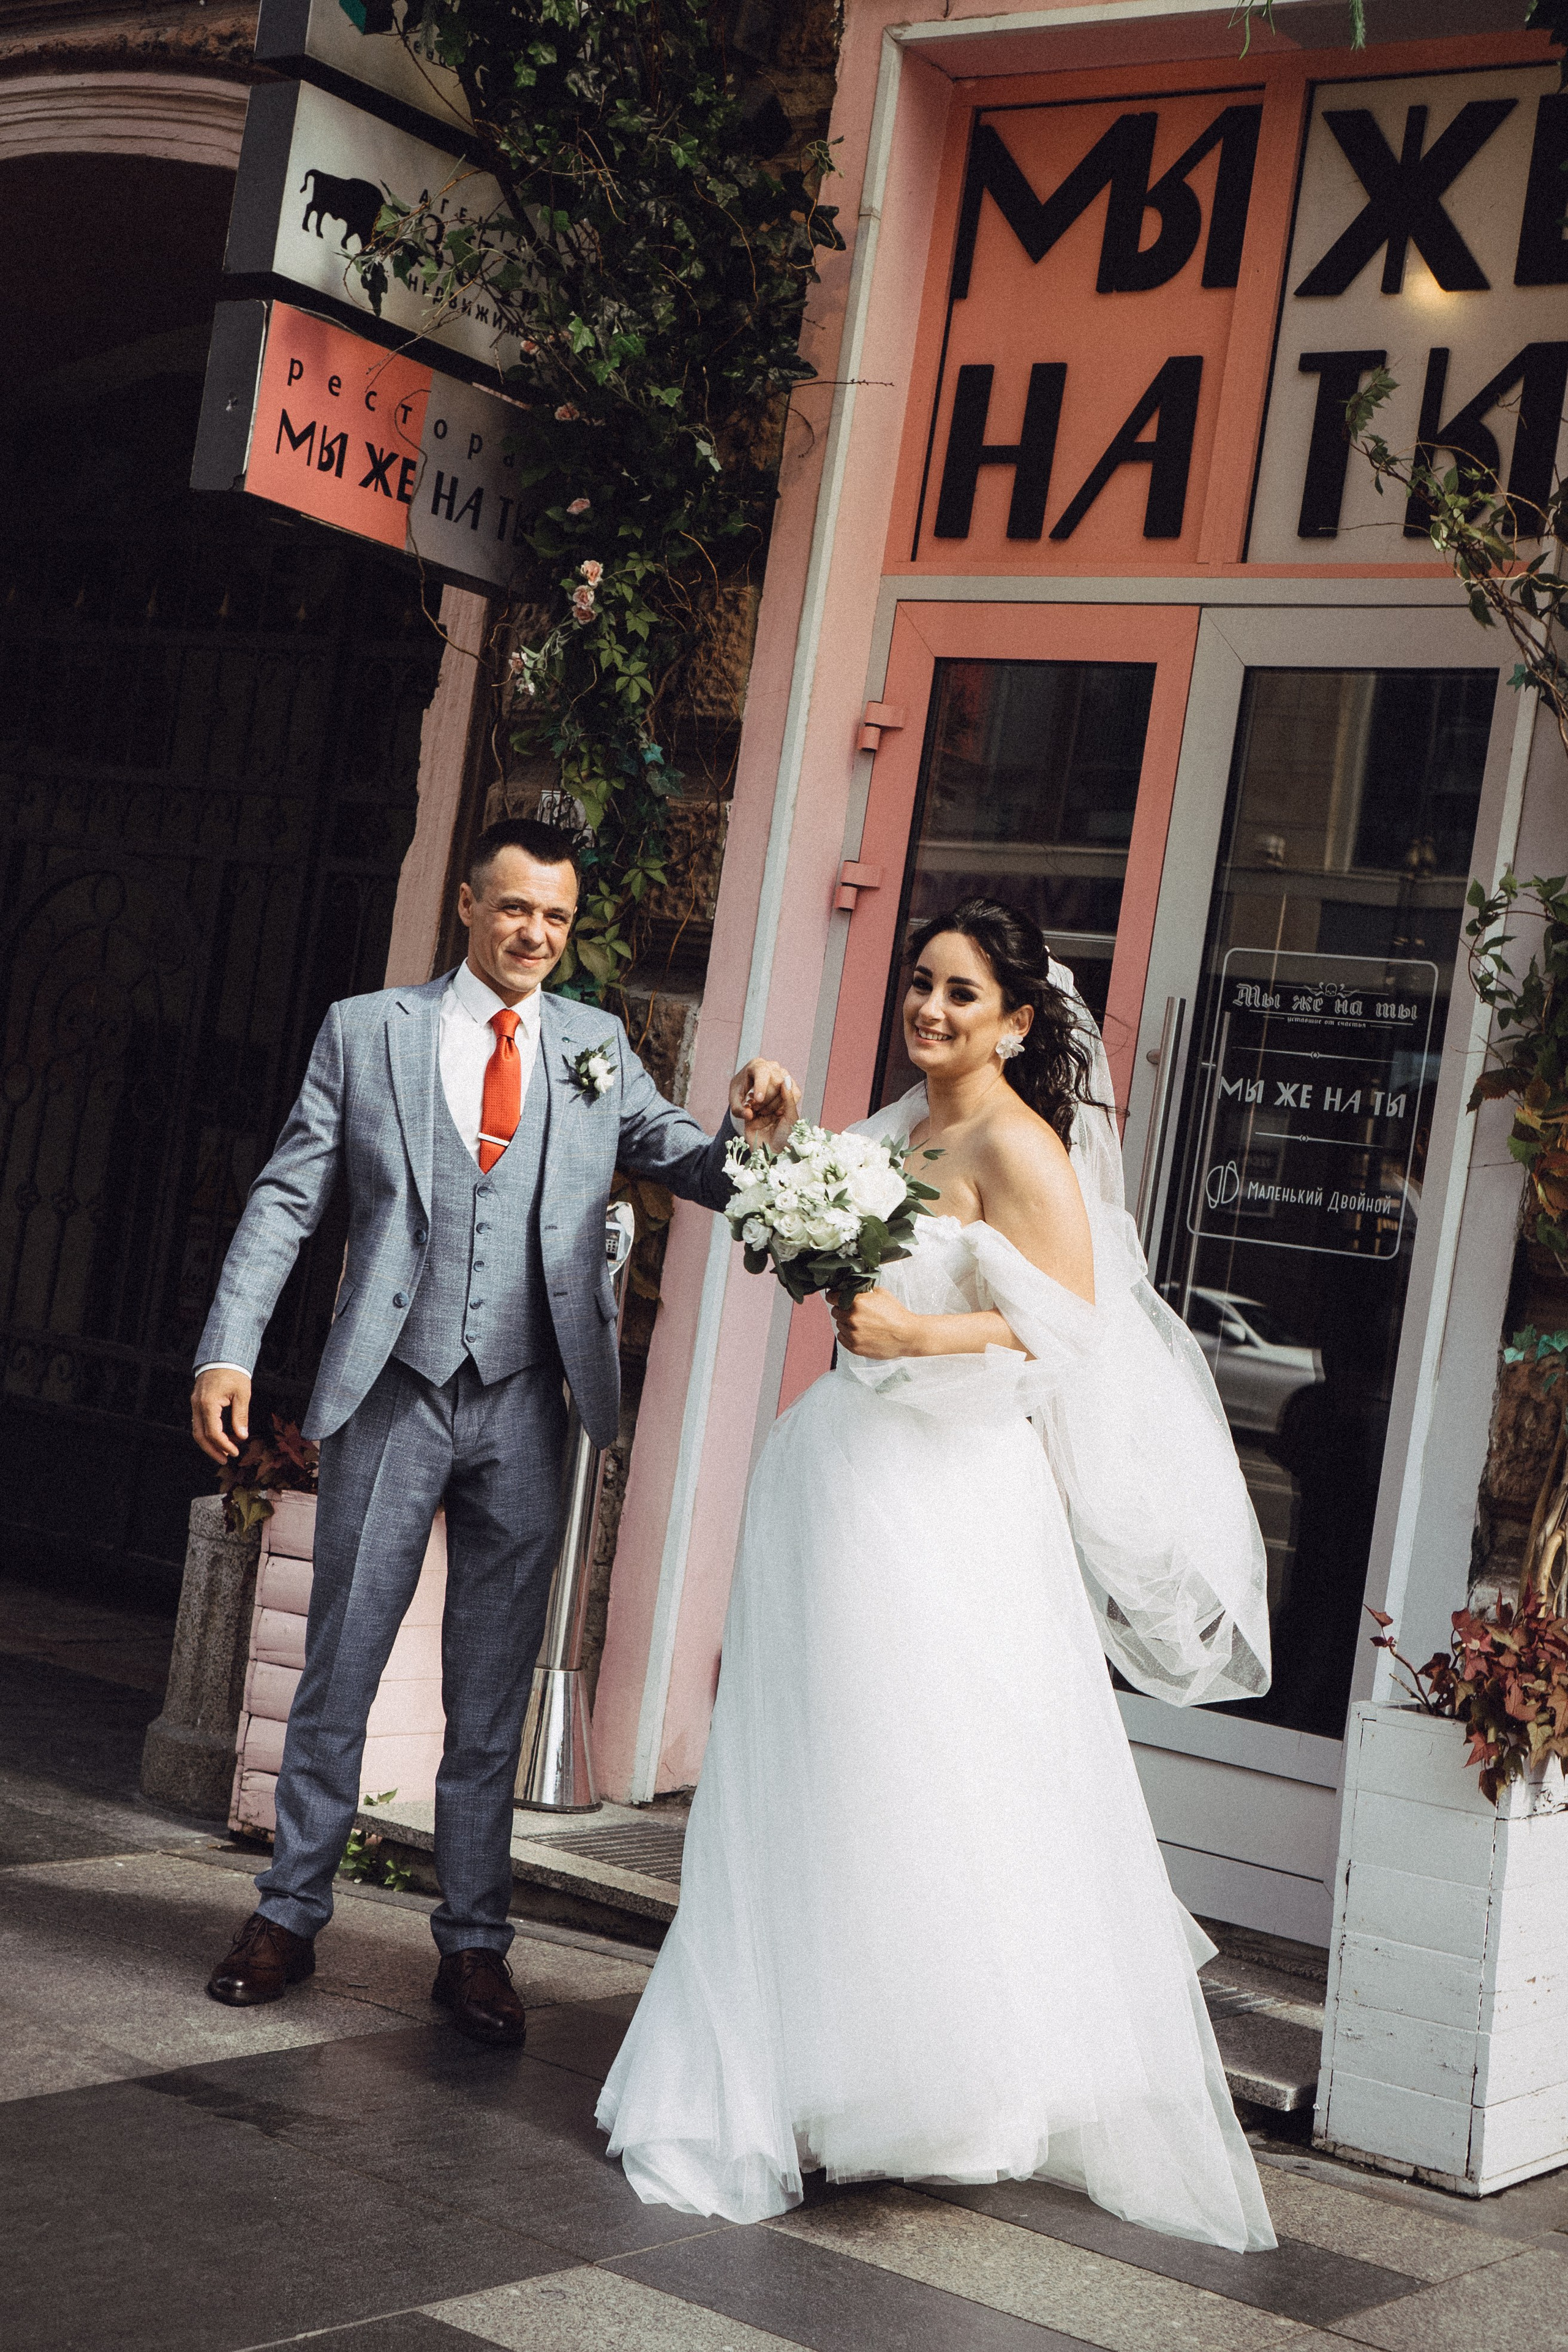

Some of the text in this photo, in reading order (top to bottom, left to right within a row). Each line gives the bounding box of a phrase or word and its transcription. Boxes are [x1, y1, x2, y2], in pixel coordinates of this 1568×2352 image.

[952, 104, 1264, 300] МЫ
[276, 408, 349, 478] МЫ
[358, 441, 417, 505] ЖЕ
[431, 470, 484, 531] НА
[934, 340, 1568, 540] НА ТЫ
[1232, 982, 1281, 1009] Мы
[1292, 995, 1324, 1012] же
[1334, 998, 1363, 1016] на
[1218, 1076, 1407, 1118] МЫ ЖЕ НА ТЫ
